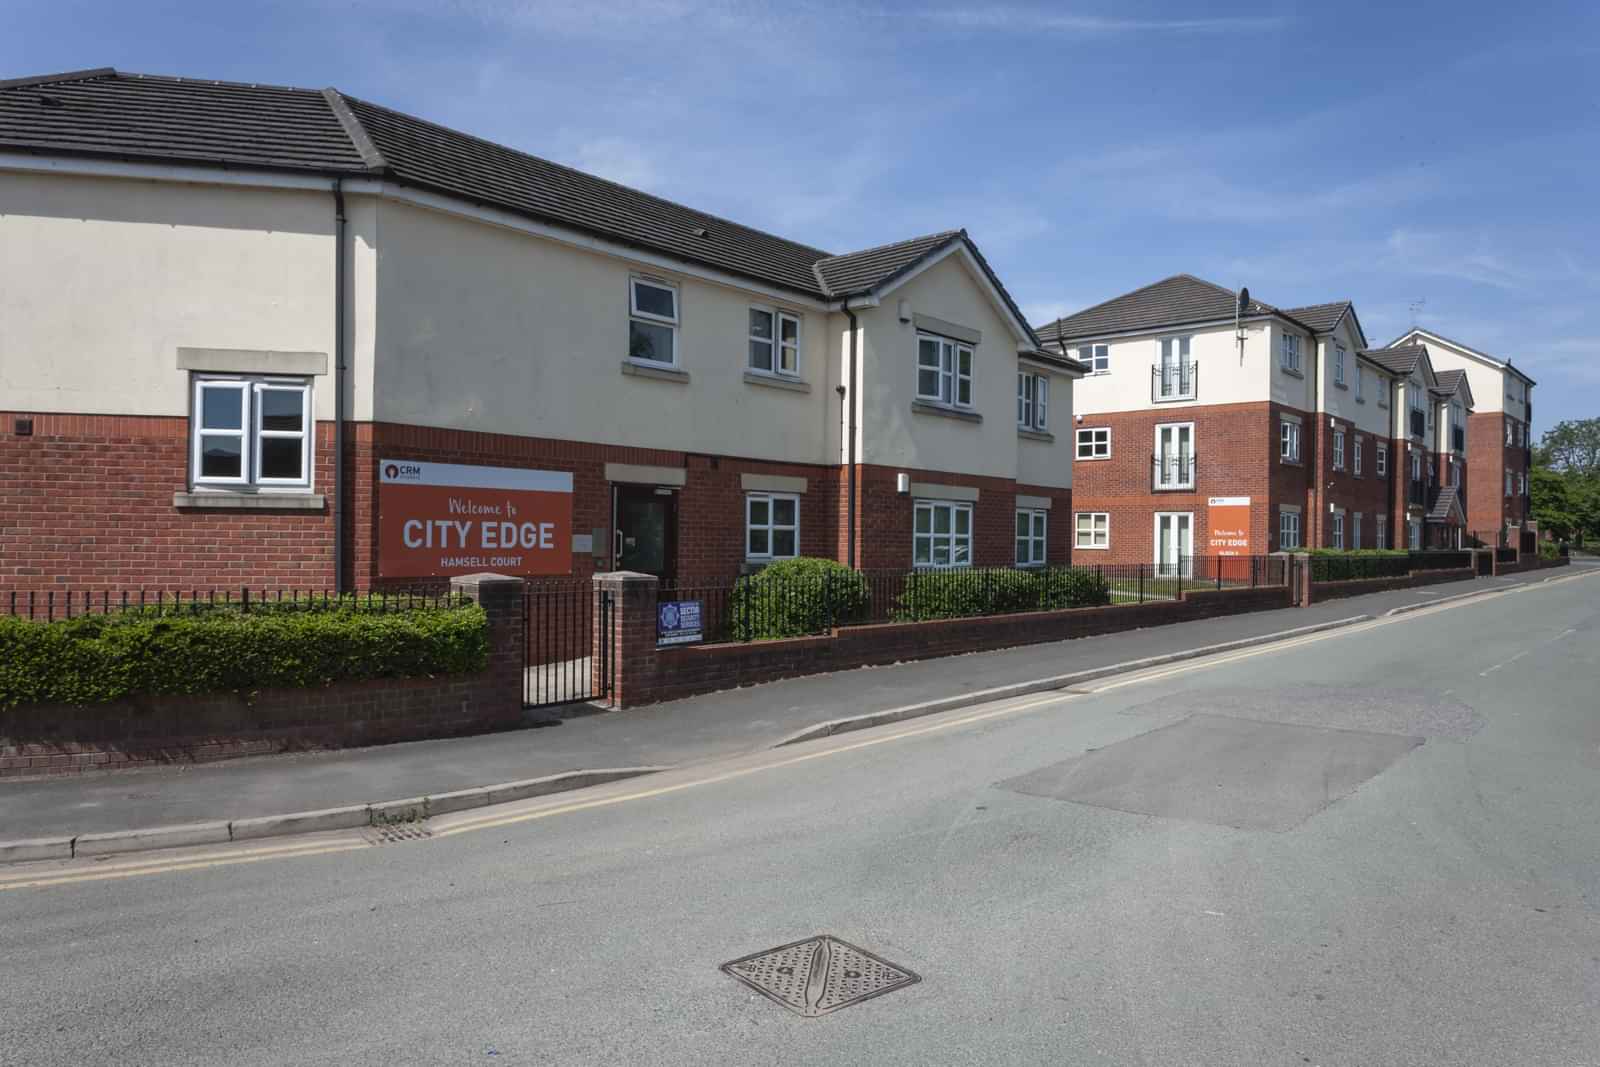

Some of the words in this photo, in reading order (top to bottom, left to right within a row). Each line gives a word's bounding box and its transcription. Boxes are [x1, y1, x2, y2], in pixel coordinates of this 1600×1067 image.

[400, 465, 421, 475] CRM
[449, 498, 502, 515] Welcome
[507, 500, 518, 519] to
[403, 519, 473, 549] CITY
[481, 521, 555, 550] EDGE
[1210, 539, 1227, 547] CITY
[1228, 539, 1248, 547] EDGE
[440, 557, 489, 568] HAMSELL
[490, 557, 524, 568] COURT
